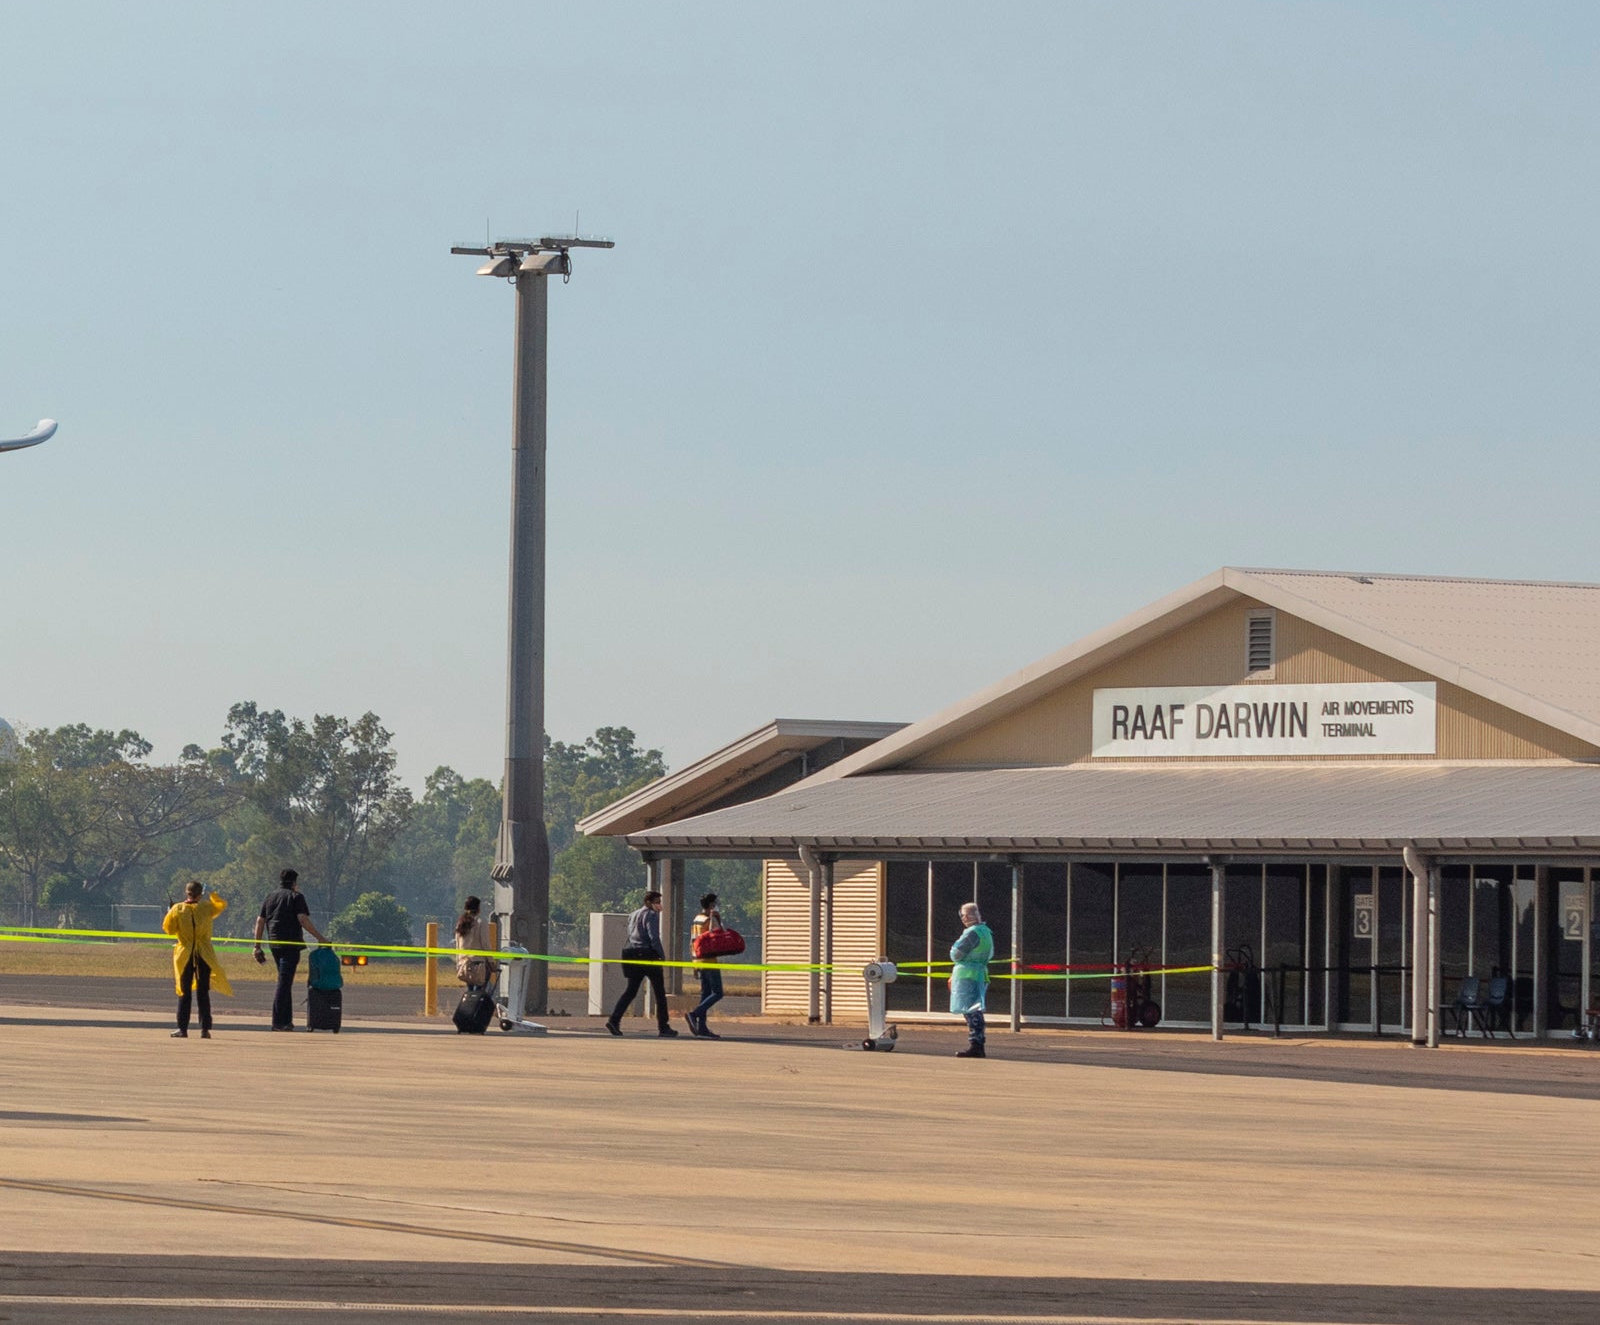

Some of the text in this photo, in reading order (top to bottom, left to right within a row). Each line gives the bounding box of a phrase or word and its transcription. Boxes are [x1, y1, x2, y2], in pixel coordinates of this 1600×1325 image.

[1321, 700, 1414, 715] AIR MOVEMENTS
[1112, 702, 1308, 740] RAAF DARWIN
[1321, 723, 1376, 737] TERMINAL
[1359, 910, 1369, 934] 3
[1569, 911, 1580, 934] 2
